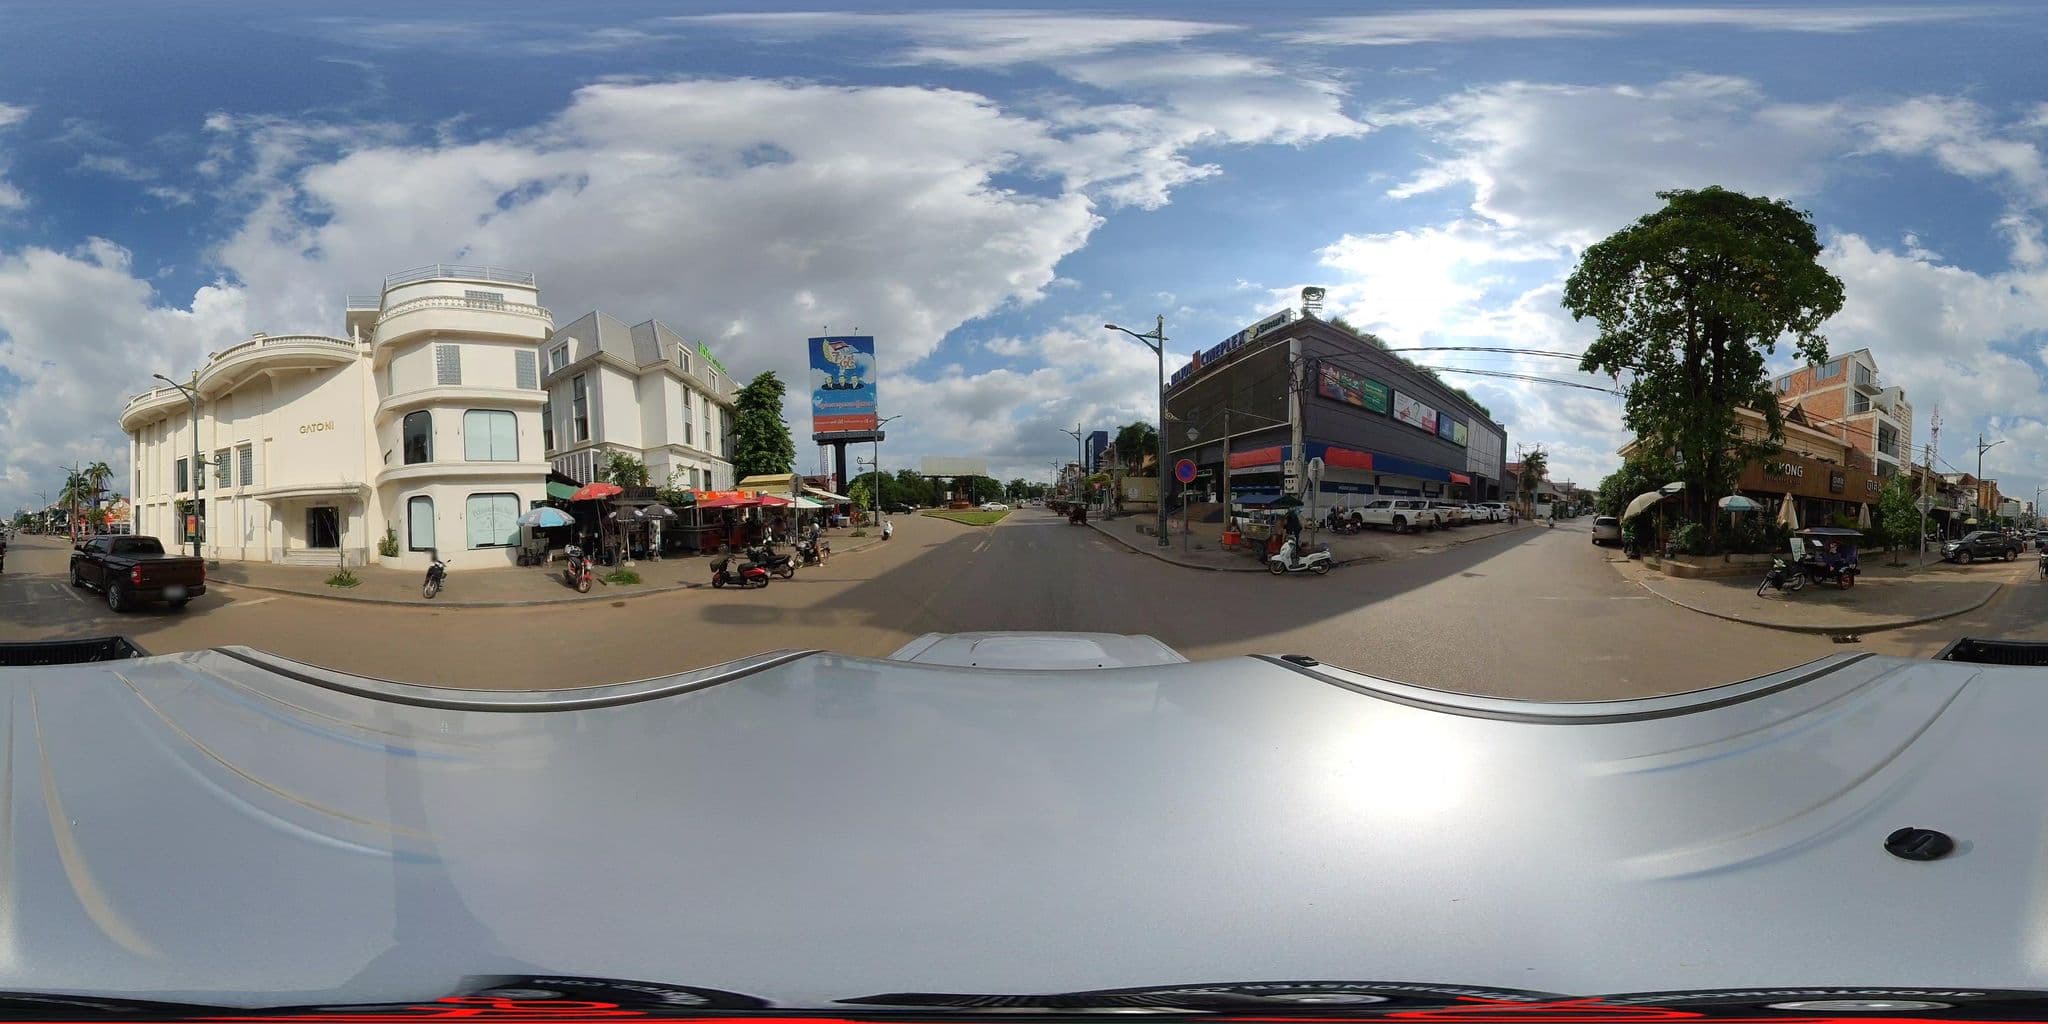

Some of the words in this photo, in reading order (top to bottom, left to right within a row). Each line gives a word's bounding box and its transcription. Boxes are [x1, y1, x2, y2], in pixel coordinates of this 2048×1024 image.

[1259, 313, 1286, 333] Smart
[1200, 330, 1247, 365] CINEPLEX
[299, 421, 335, 434] GATONI
